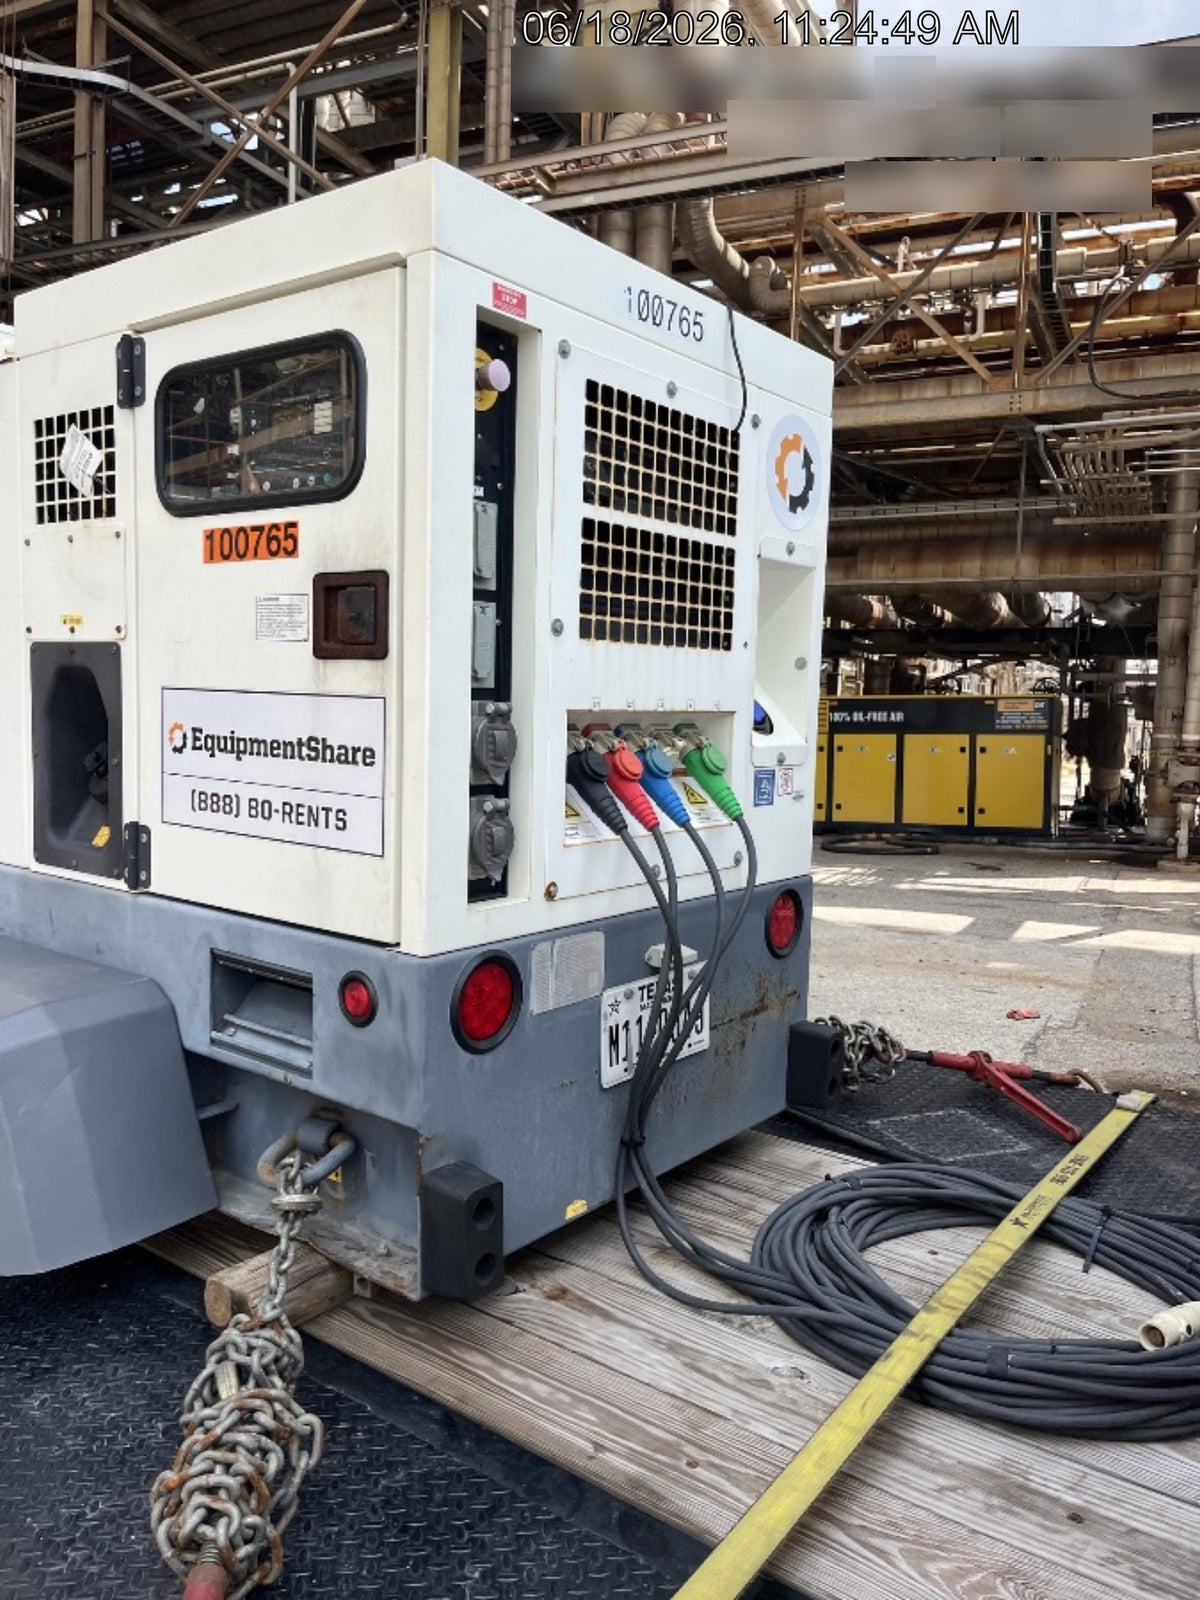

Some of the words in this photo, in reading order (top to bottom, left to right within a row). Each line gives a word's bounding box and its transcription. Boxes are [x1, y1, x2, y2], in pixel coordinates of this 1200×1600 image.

[623, 286, 705, 342] 100765
[205, 521, 298, 561] 100765
[191, 726, 376, 767] EquipmentShare
